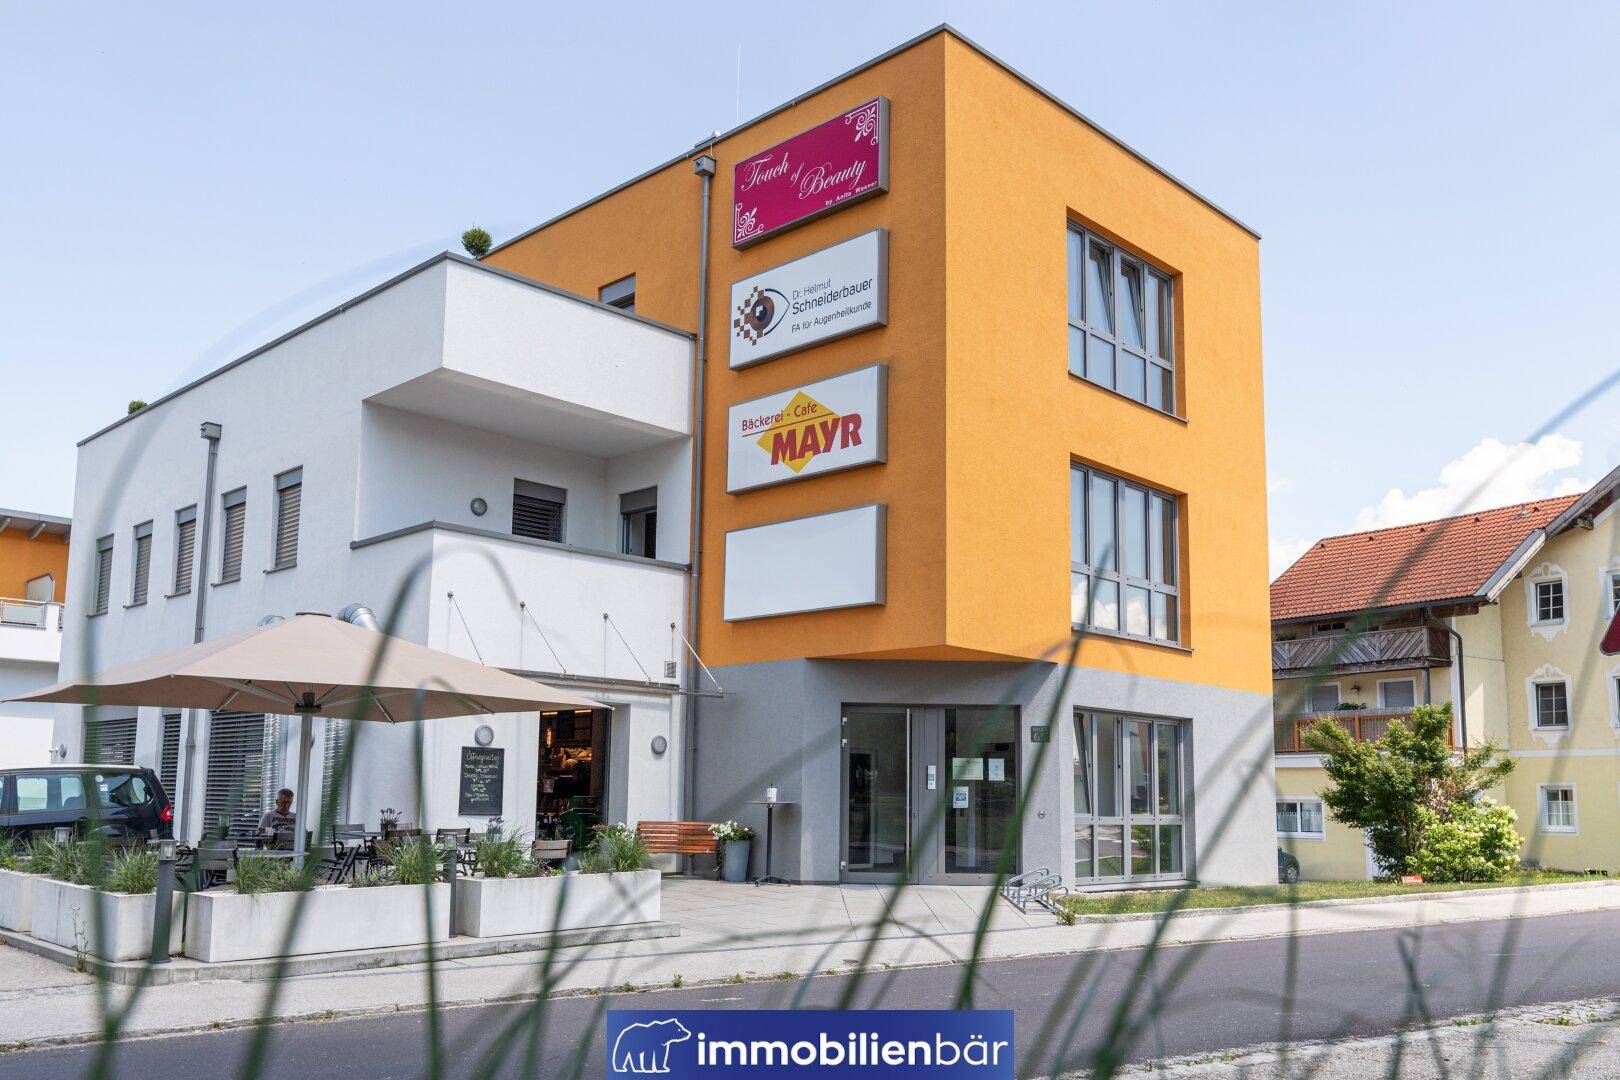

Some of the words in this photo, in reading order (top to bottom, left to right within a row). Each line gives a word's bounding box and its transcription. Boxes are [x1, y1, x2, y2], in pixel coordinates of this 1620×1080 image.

[741, 152, 789, 191] Touch
[790, 162, 804, 187] of
[799, 161, 866, 199] Beauty
[792, 290, 802, 300] Dr.
[803, 278, 831, 295] Helmut
[792, 278, 873, 315] Schneiderbauer
[791, 323, 801, 334] FA
[802, 319, 812, 330] für
[813, 300, 872, 327] Augenheilkunde
[742, 411, 784, 432] Bäckerei
[770, 413, 862, 465] MAYR
